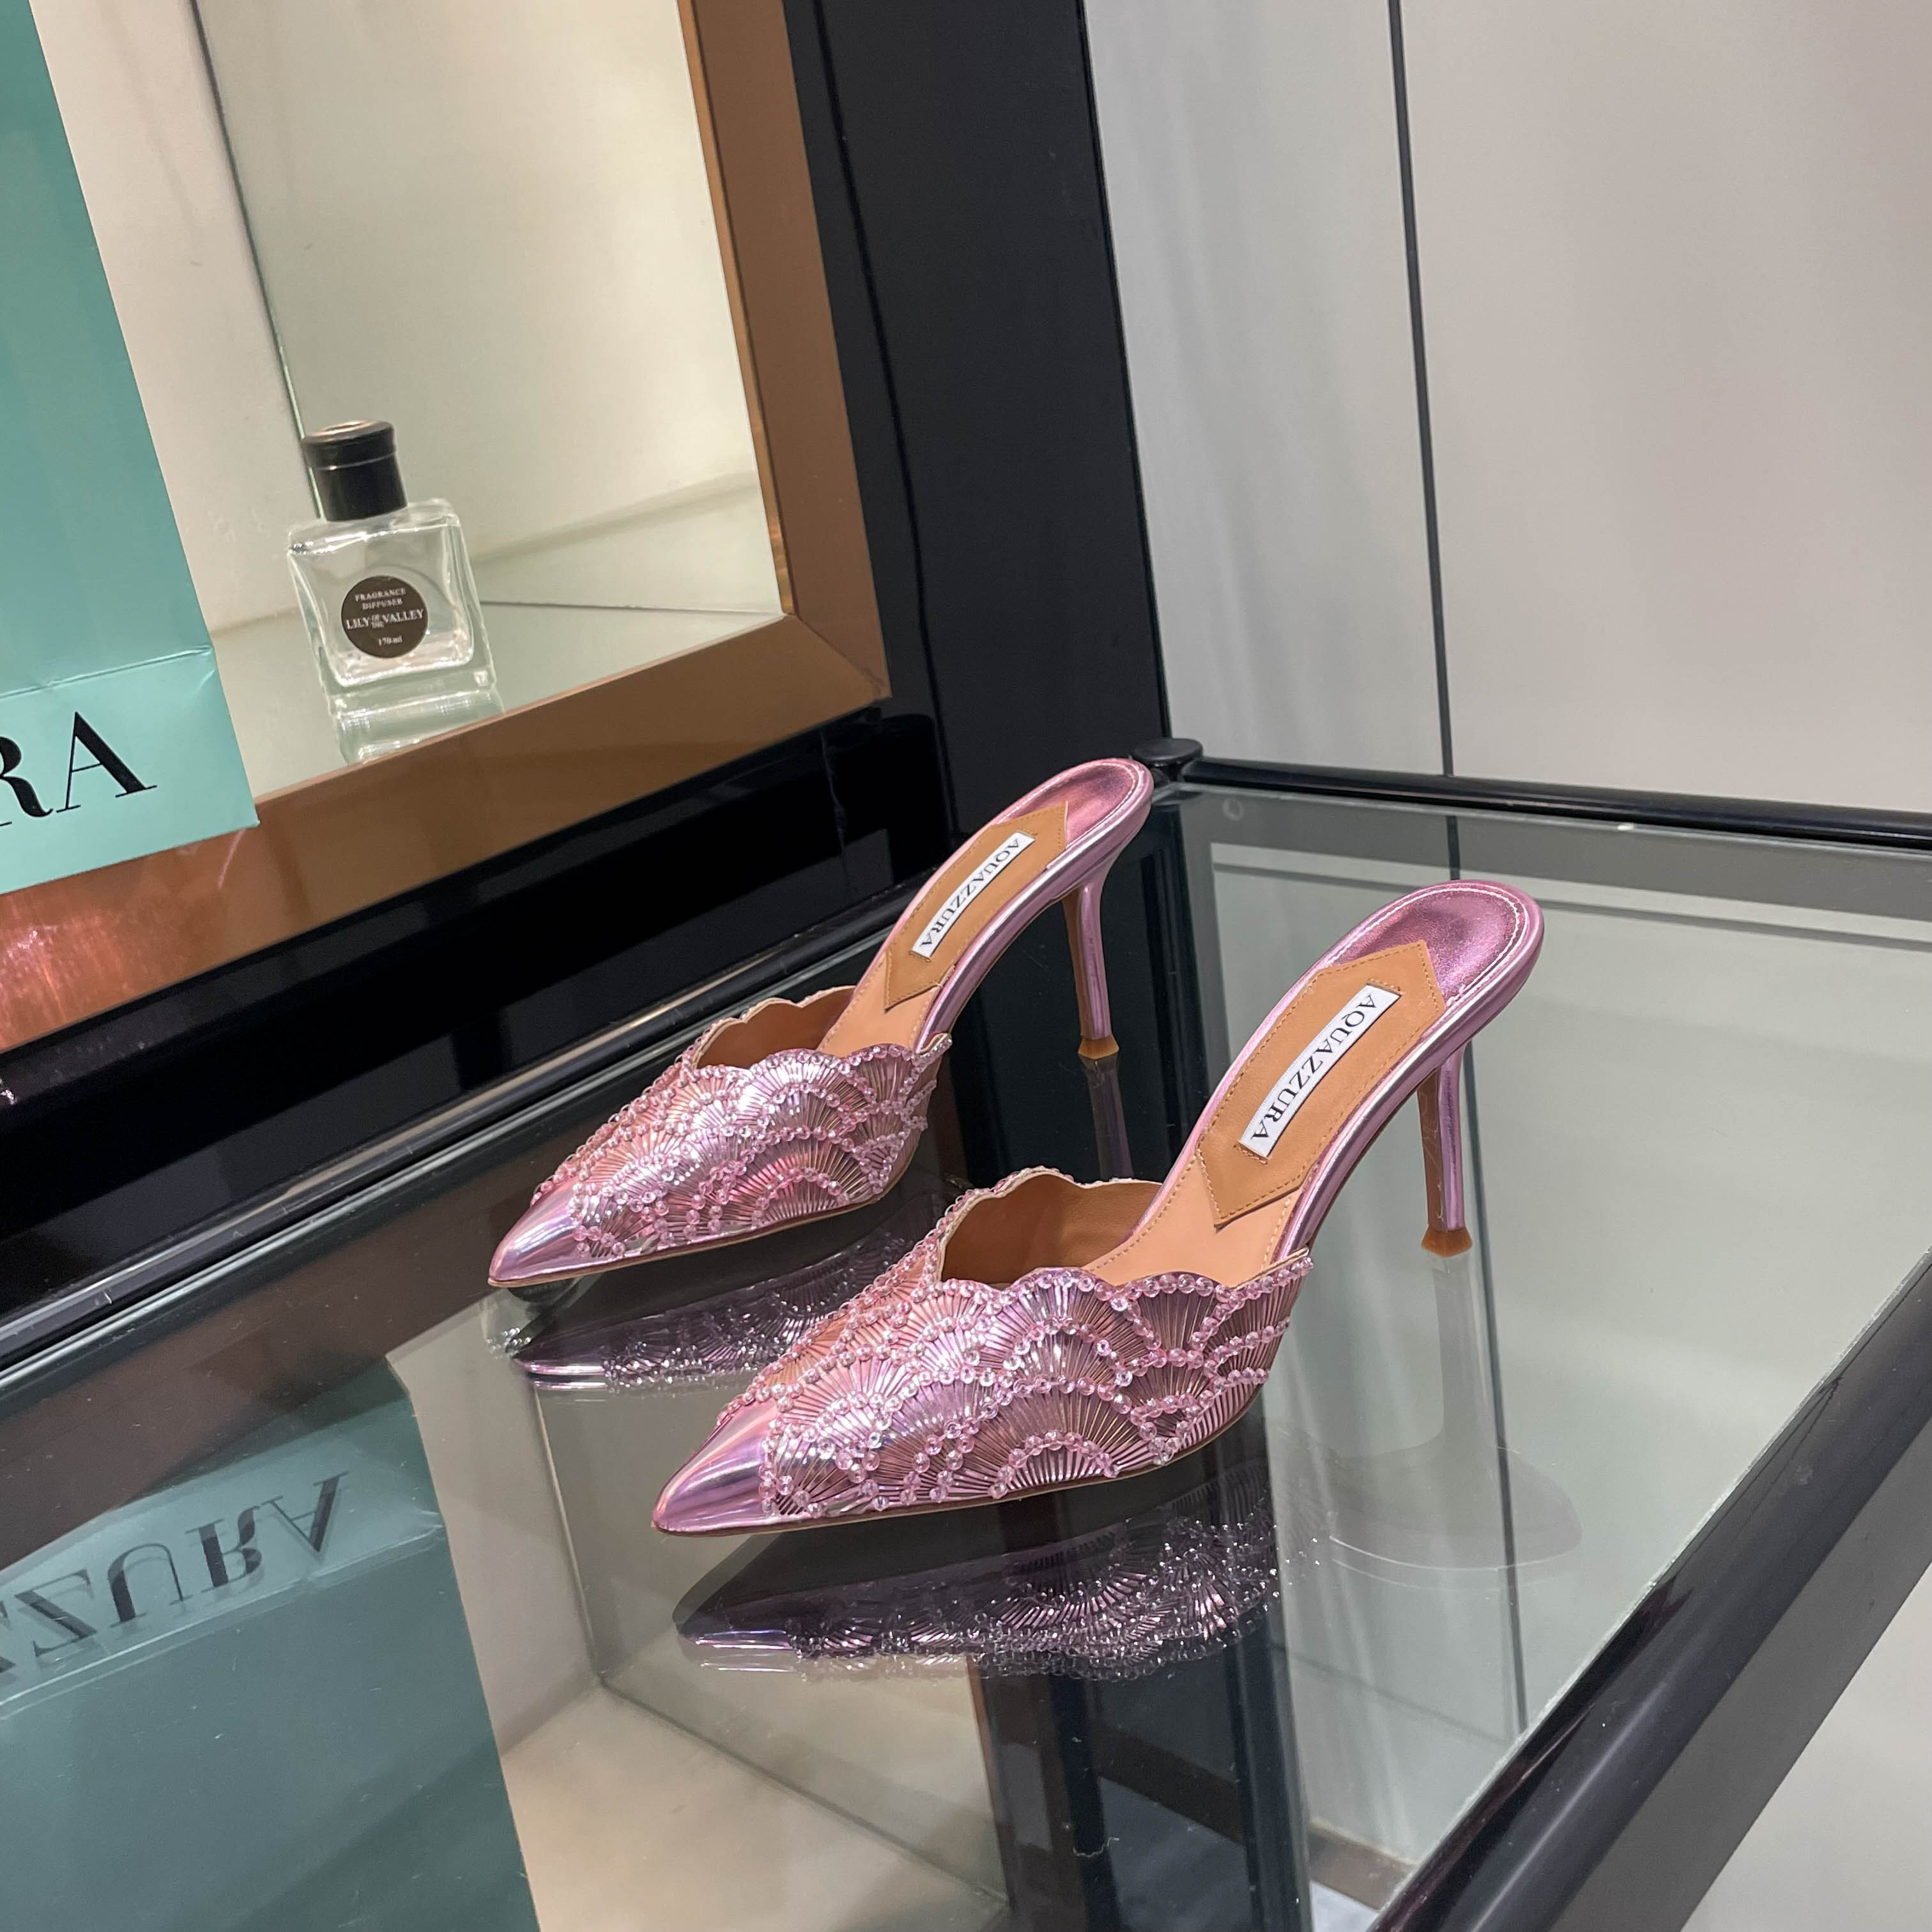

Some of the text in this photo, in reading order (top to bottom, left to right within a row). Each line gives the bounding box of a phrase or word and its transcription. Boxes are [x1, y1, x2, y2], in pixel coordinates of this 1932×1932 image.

[355, 588, 406, 602] FRAGRANCE
[362, 598, 402, 610] DIFFUSER
[346, 617, 370, 629] LILY
[382, 609, 424, 624] VALLEY
[920, 838, 1020, 947] AQUAZZURA
[1251, 993, 1377, 1140] AQUAZZURA
